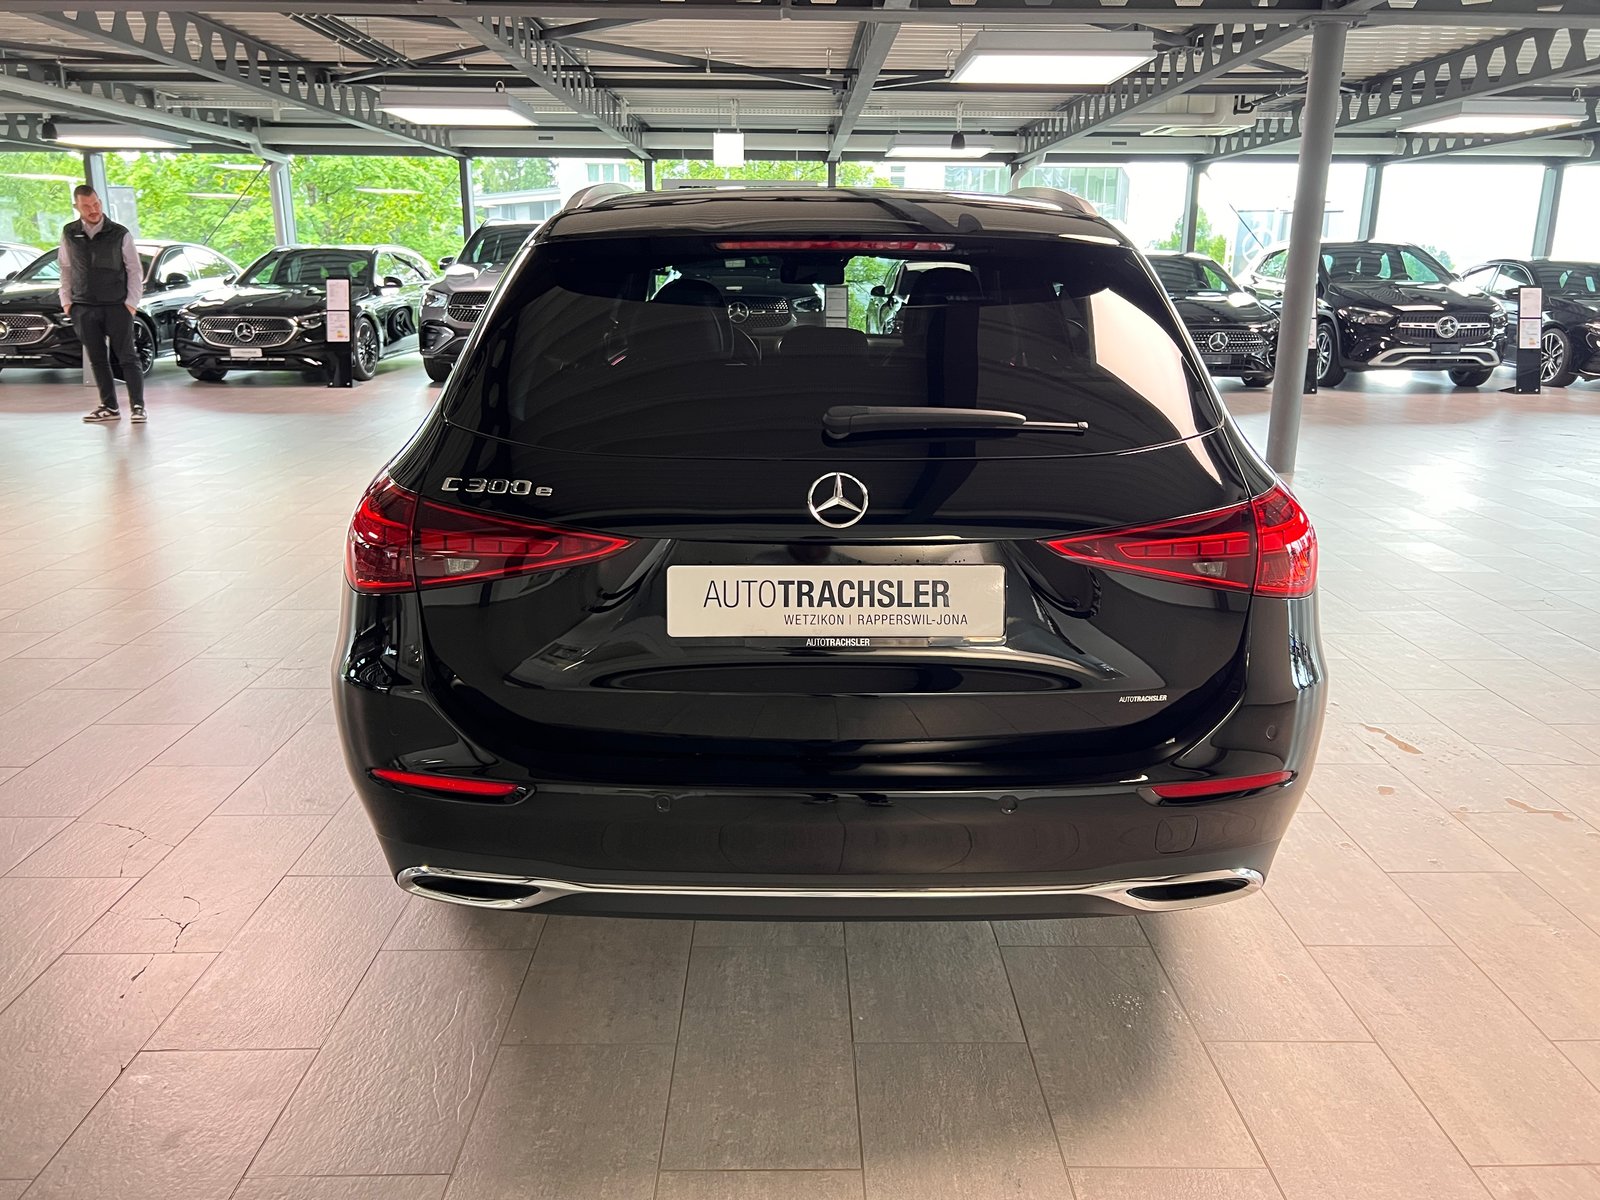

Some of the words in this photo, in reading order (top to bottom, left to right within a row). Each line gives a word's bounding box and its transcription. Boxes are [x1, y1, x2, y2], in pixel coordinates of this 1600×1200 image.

[703, 579, 950, 608] AUTOTRACHSLER
[784, 614, 844, 625] WETZIKON
[857, 614, 968, 625] RAPPERSWIL-JONA
[806, 638, 870, 647] AUTOTRACHSLER
[1118, 694, 1167, 703] AUTOTRACHSLER
